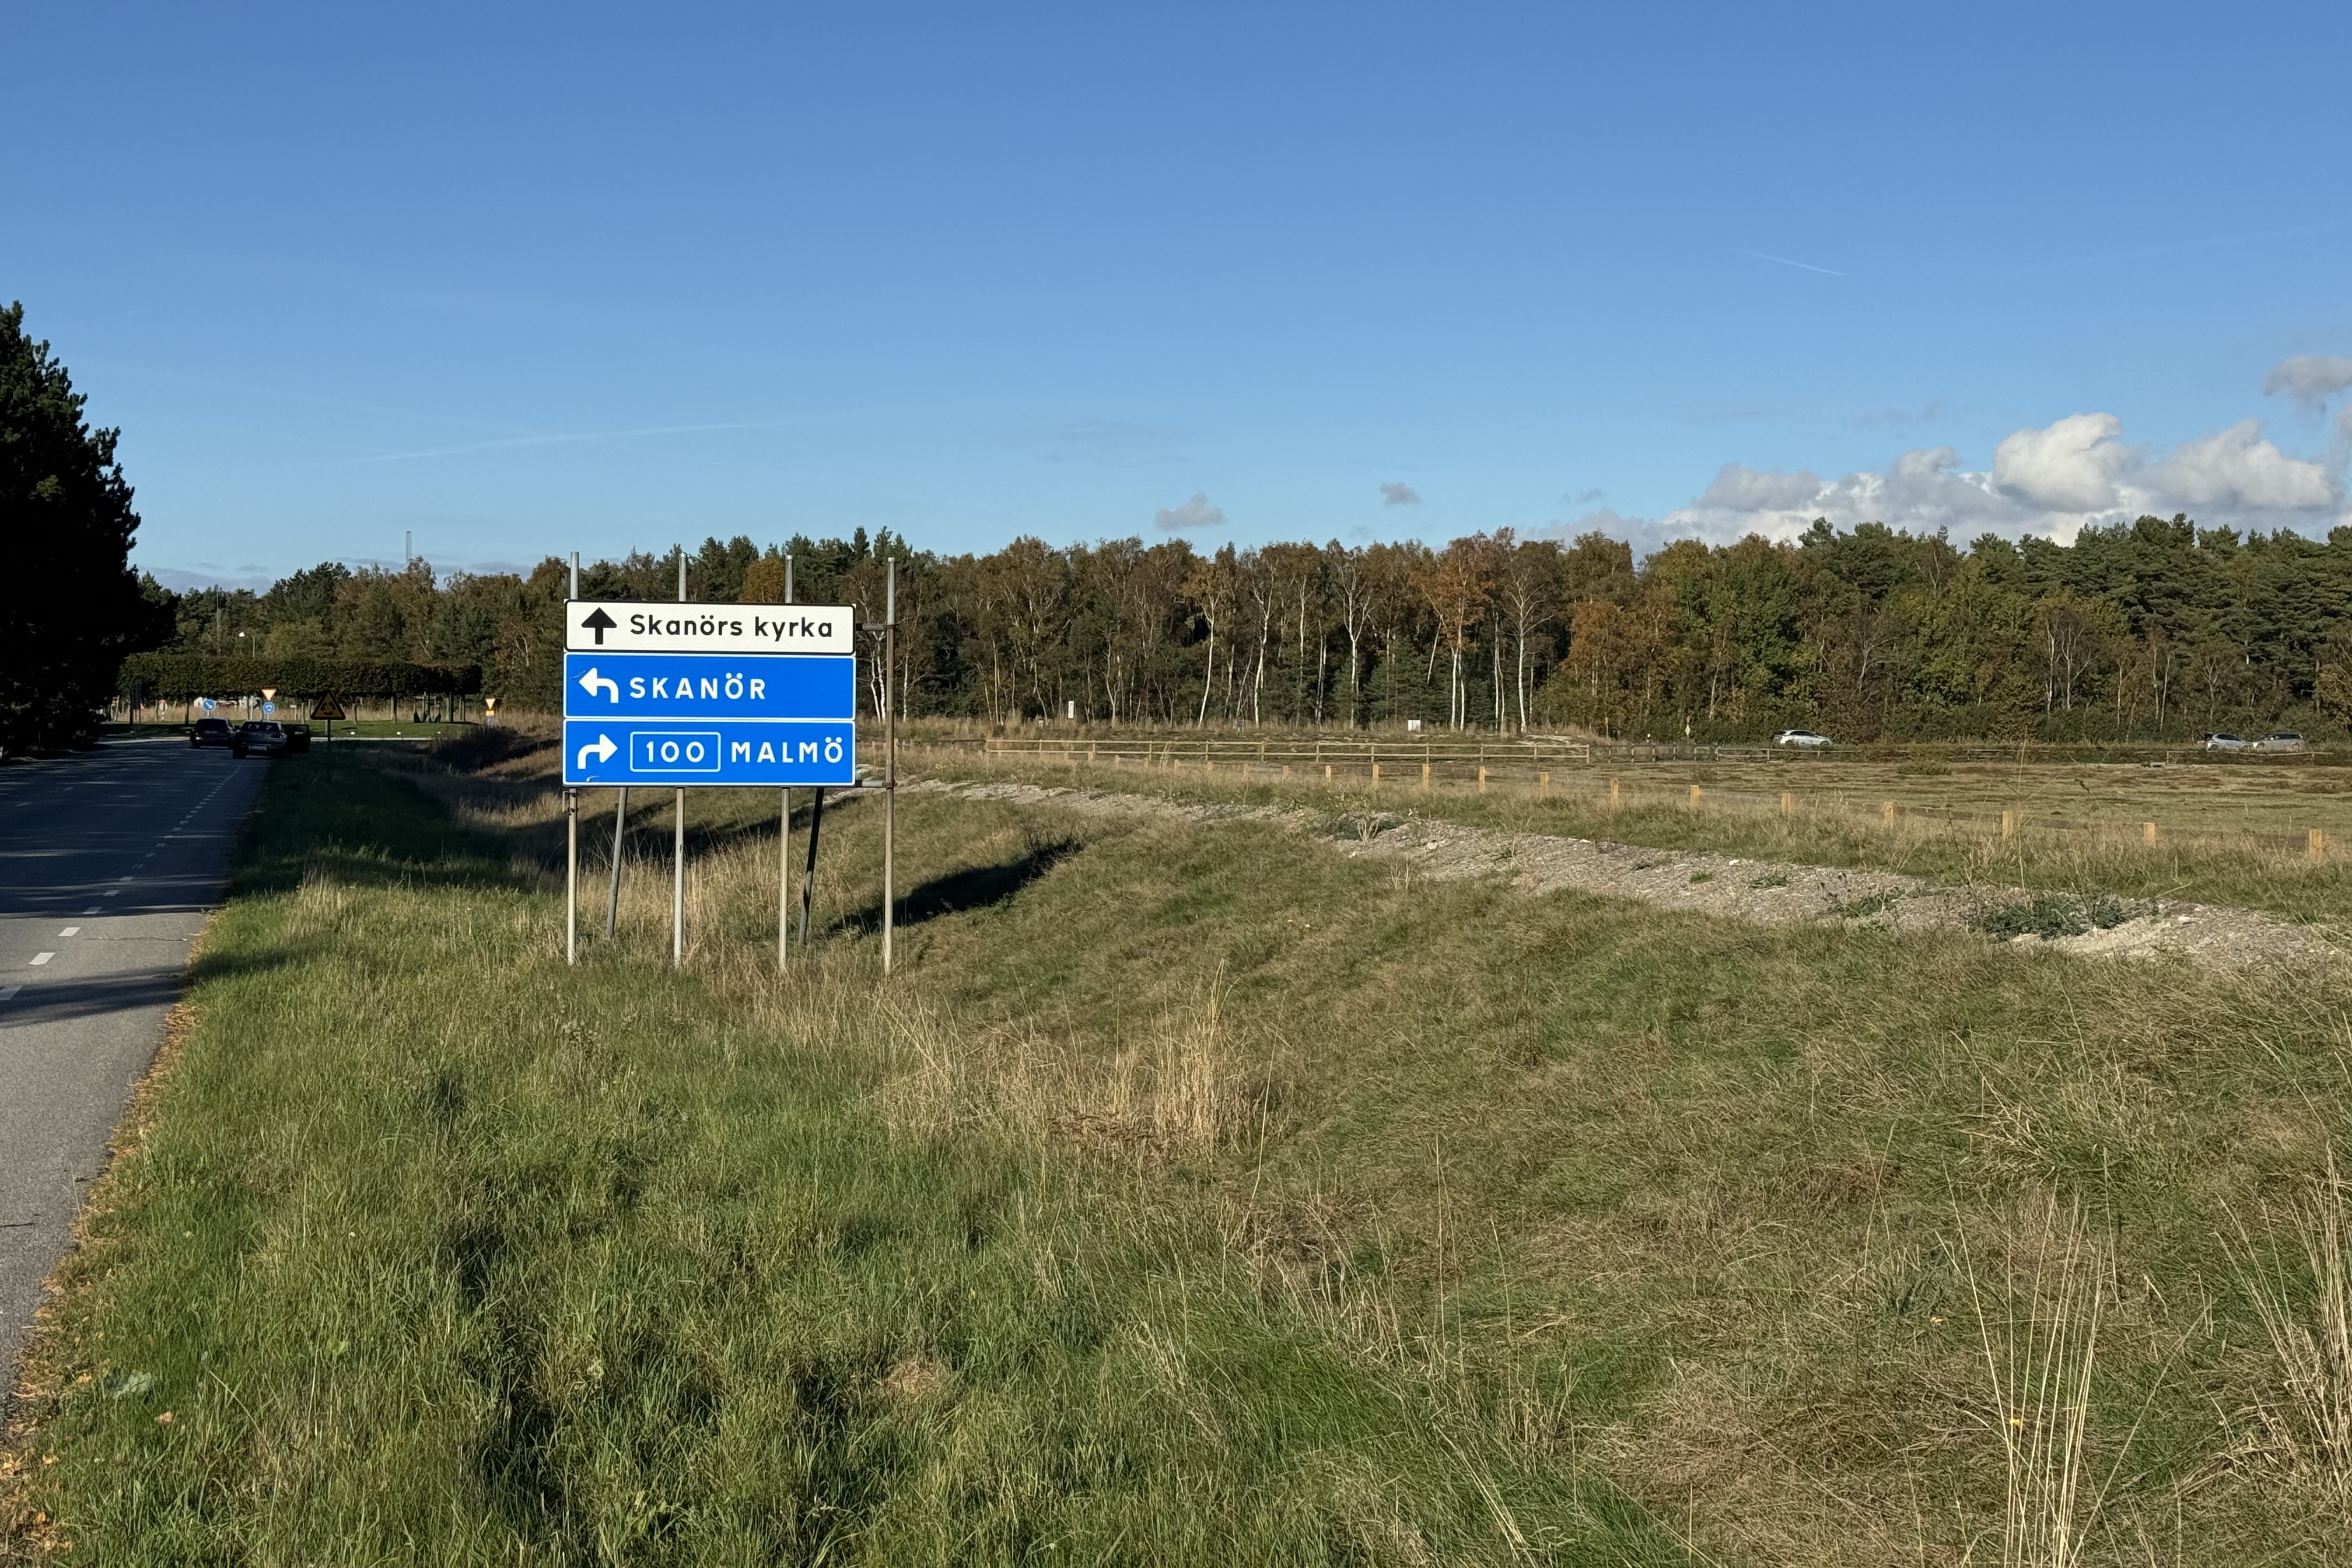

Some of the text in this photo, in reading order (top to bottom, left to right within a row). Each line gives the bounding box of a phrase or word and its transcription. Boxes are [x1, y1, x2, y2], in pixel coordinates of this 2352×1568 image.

[630, 614, 832, 642] Skanörs kyrka
[629, 673, 765, 699] SKANÖR
[646, 737, 843, 764] 100 MALMÖ
